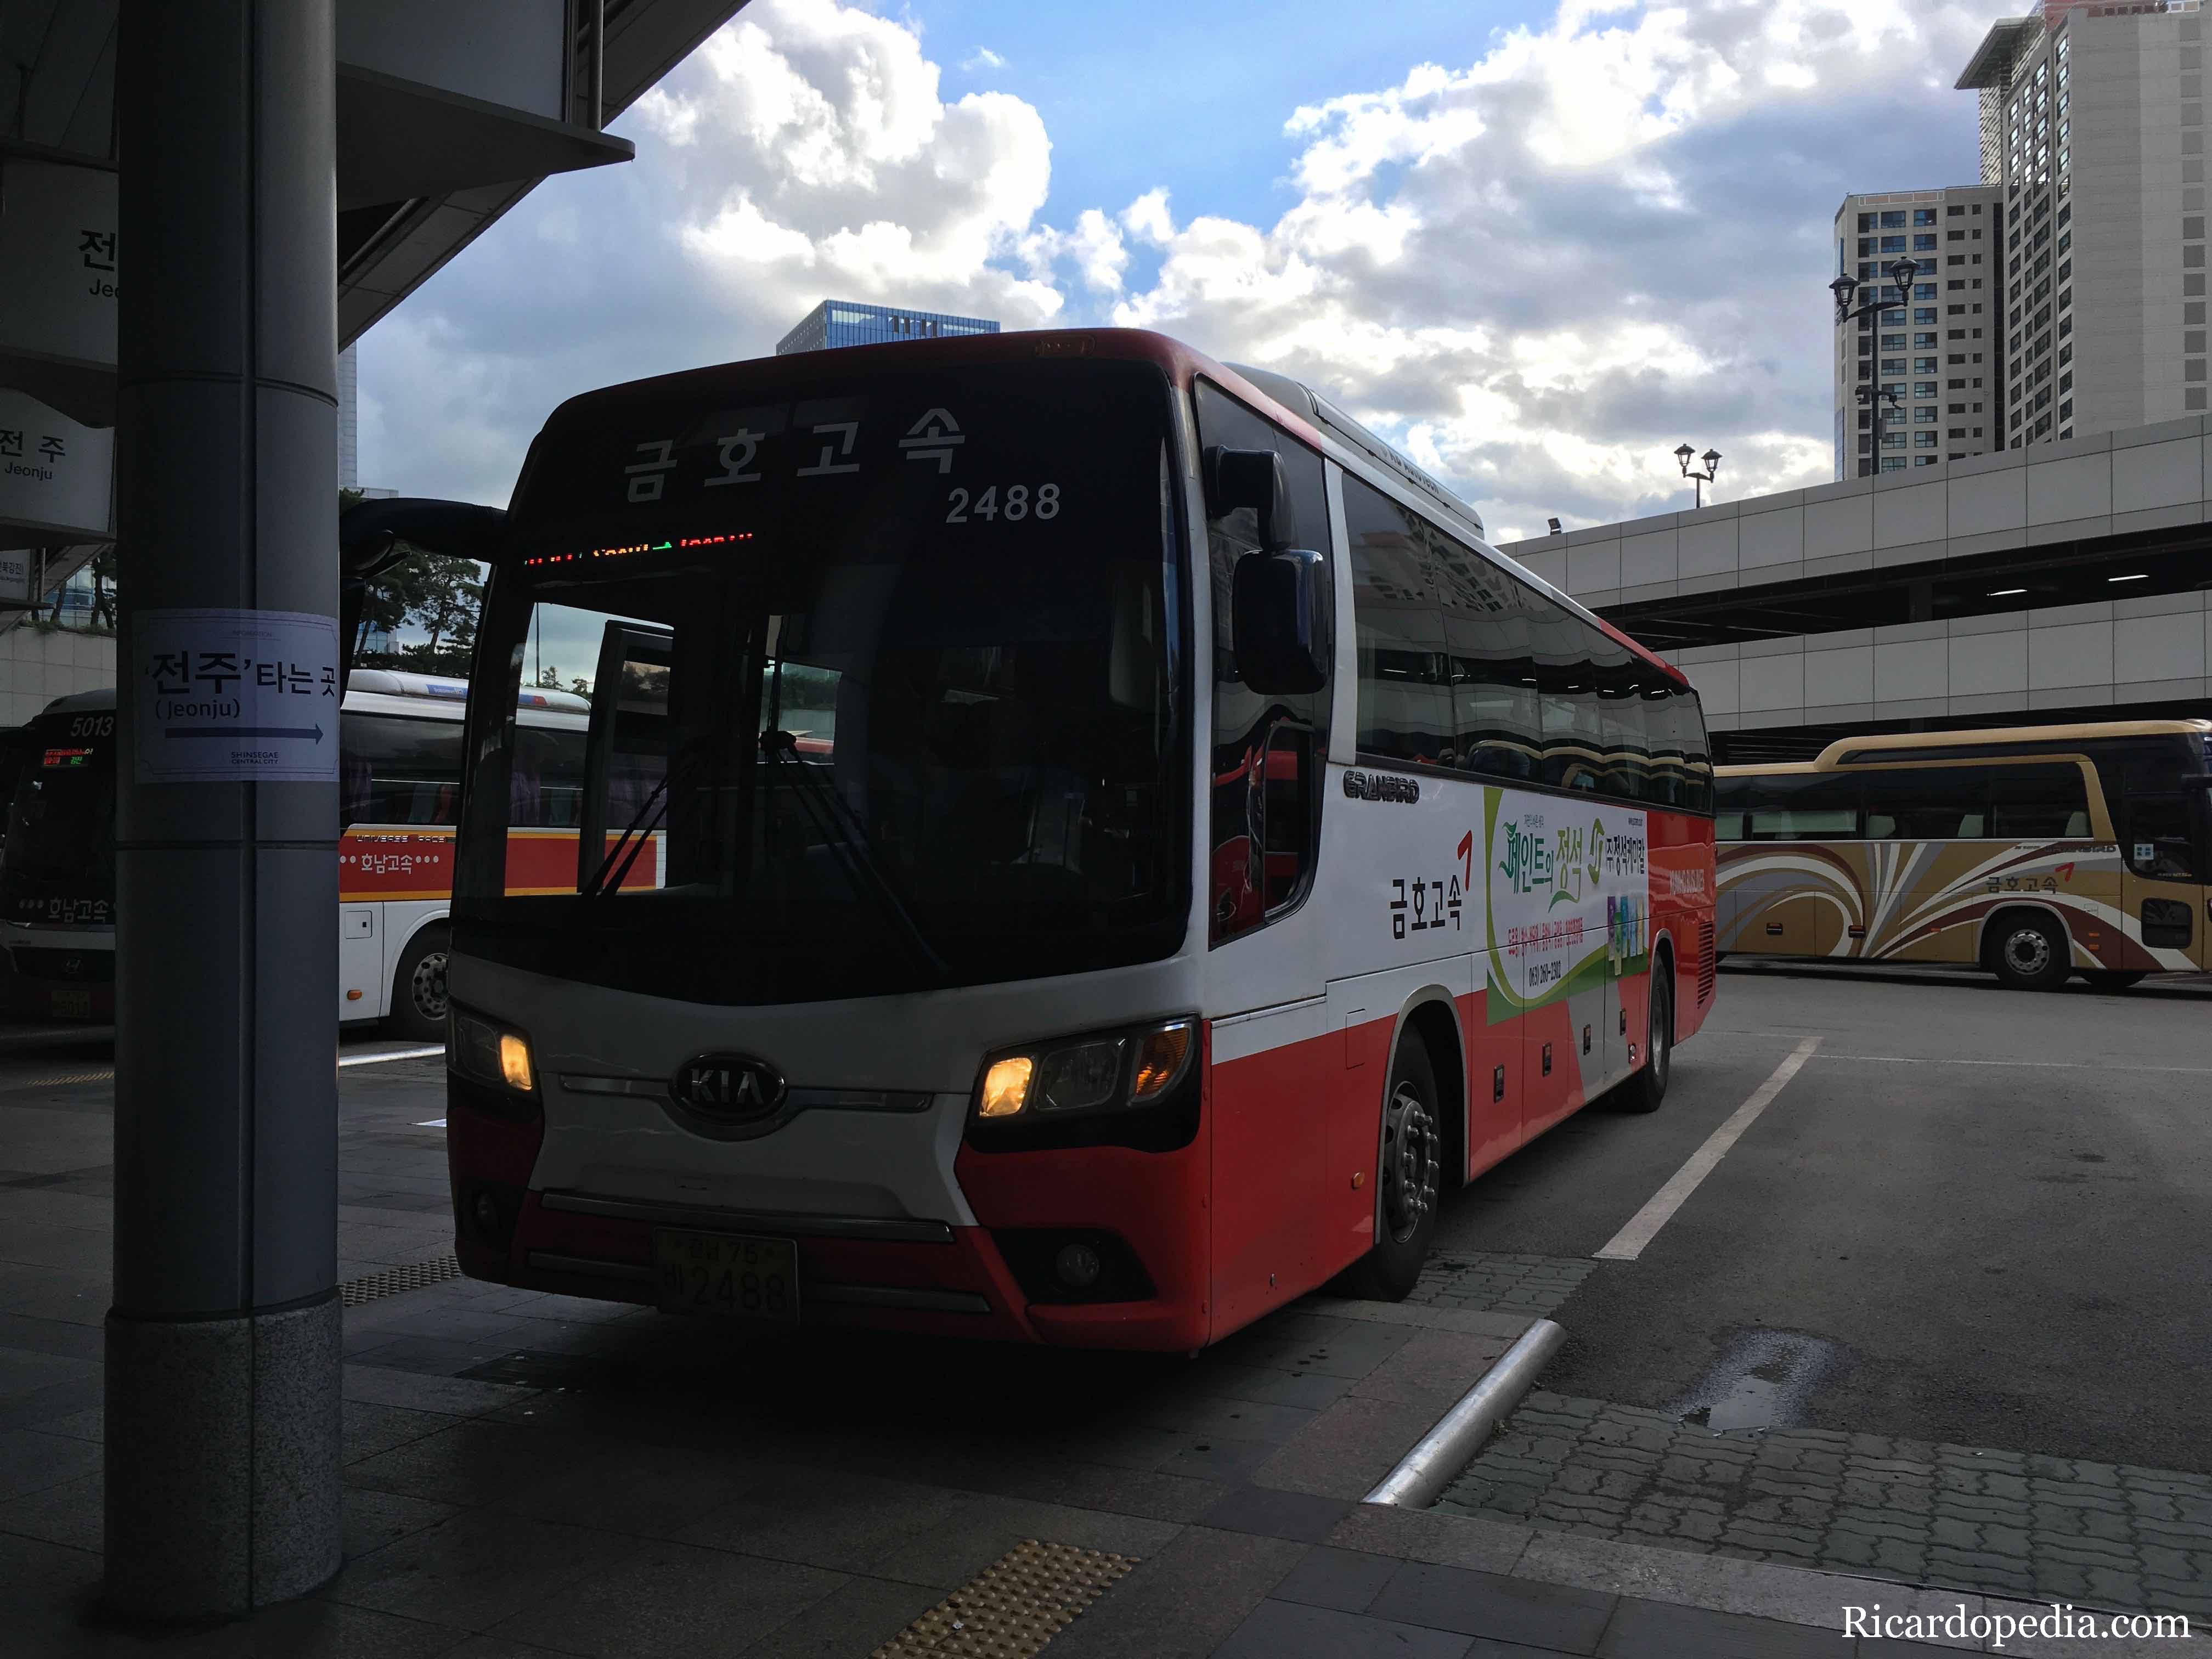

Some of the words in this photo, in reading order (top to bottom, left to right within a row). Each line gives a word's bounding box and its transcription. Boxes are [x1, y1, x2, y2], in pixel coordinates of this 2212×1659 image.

[0, 430, 66, 463] 전주
[624, 408, 966, 504] 금호고속
[5, 462, 53, 481] Jeonju
[945, 483, 1061, 524] 2488
[321, 666, 336, 697] 곳
[70, 715, 114, 737] 5013
[360, 853, 413, 875] 호남고속
[1986, 876, 2059, 895] 금호고속
[48, 895, 109, 924] 호남고속
[1390, 874, 1462, 939] 금호고속
[689, 1068, 764, 1105] KIA
[692, 1265, 789, 1313] 2488
